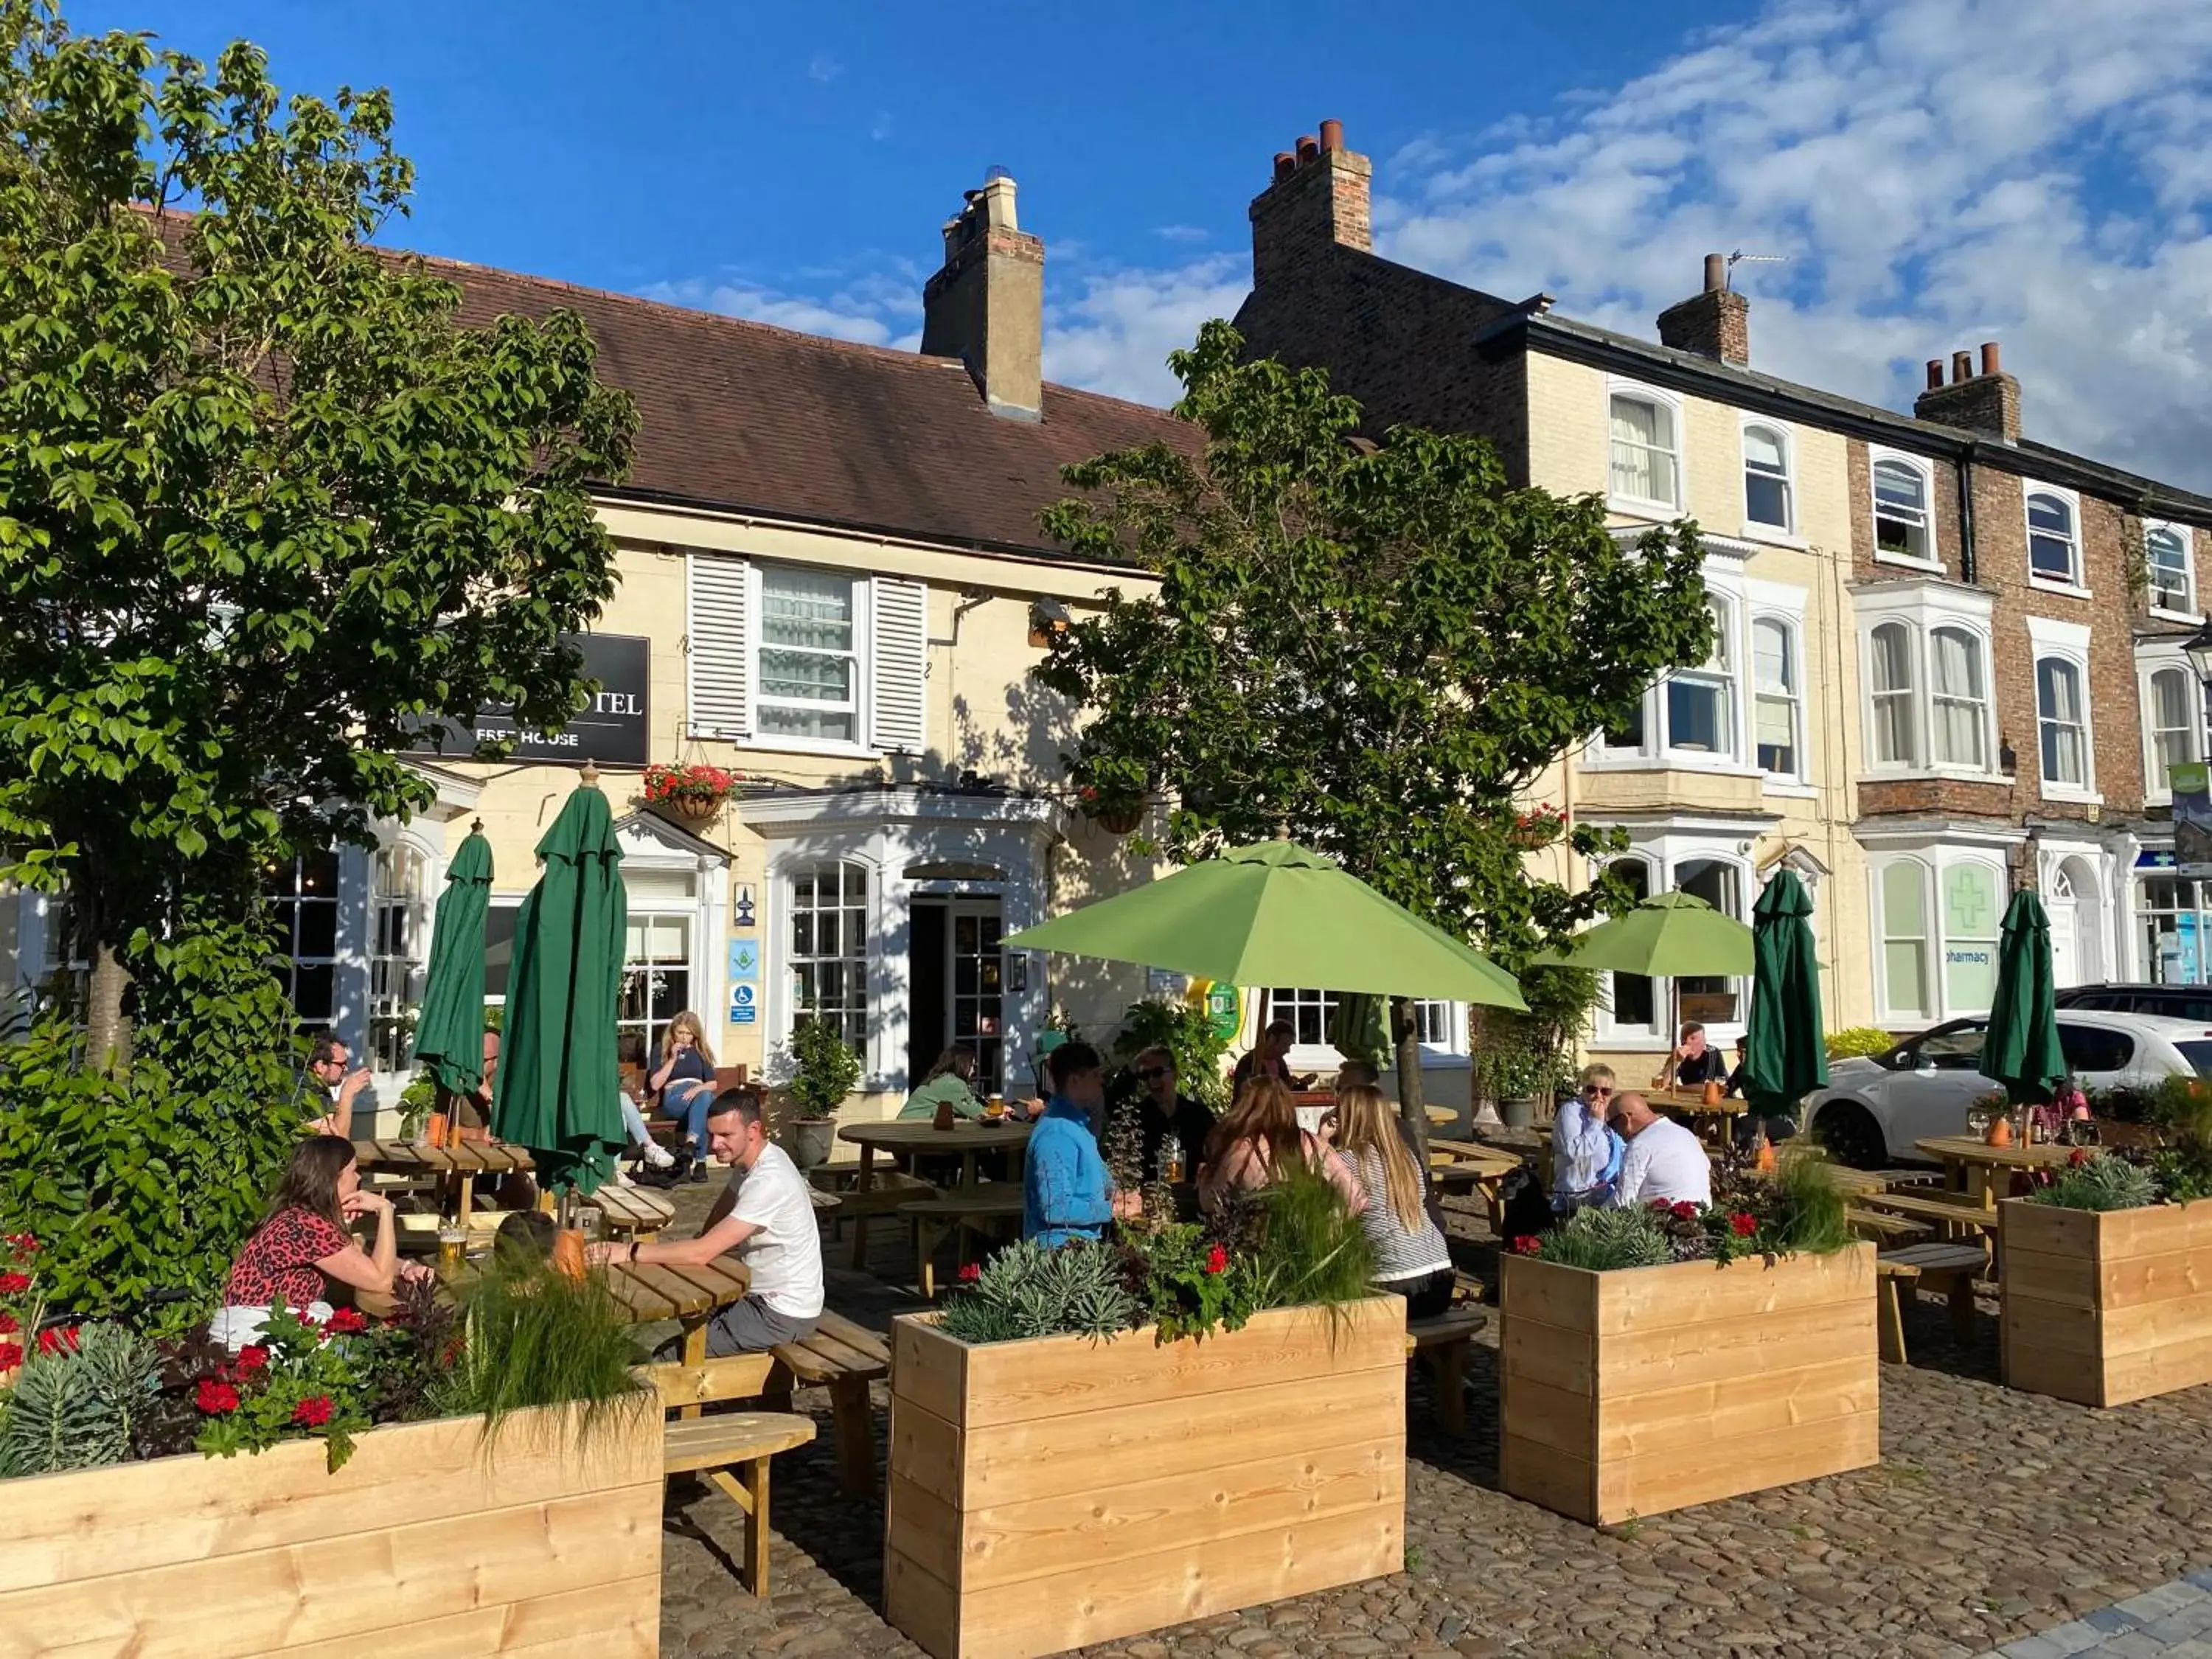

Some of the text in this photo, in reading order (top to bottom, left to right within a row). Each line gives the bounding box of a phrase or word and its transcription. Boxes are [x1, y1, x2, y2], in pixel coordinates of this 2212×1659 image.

[575, 689, 642, 715] TEL
[476, 728, 579, 746] FRE HOUSE
